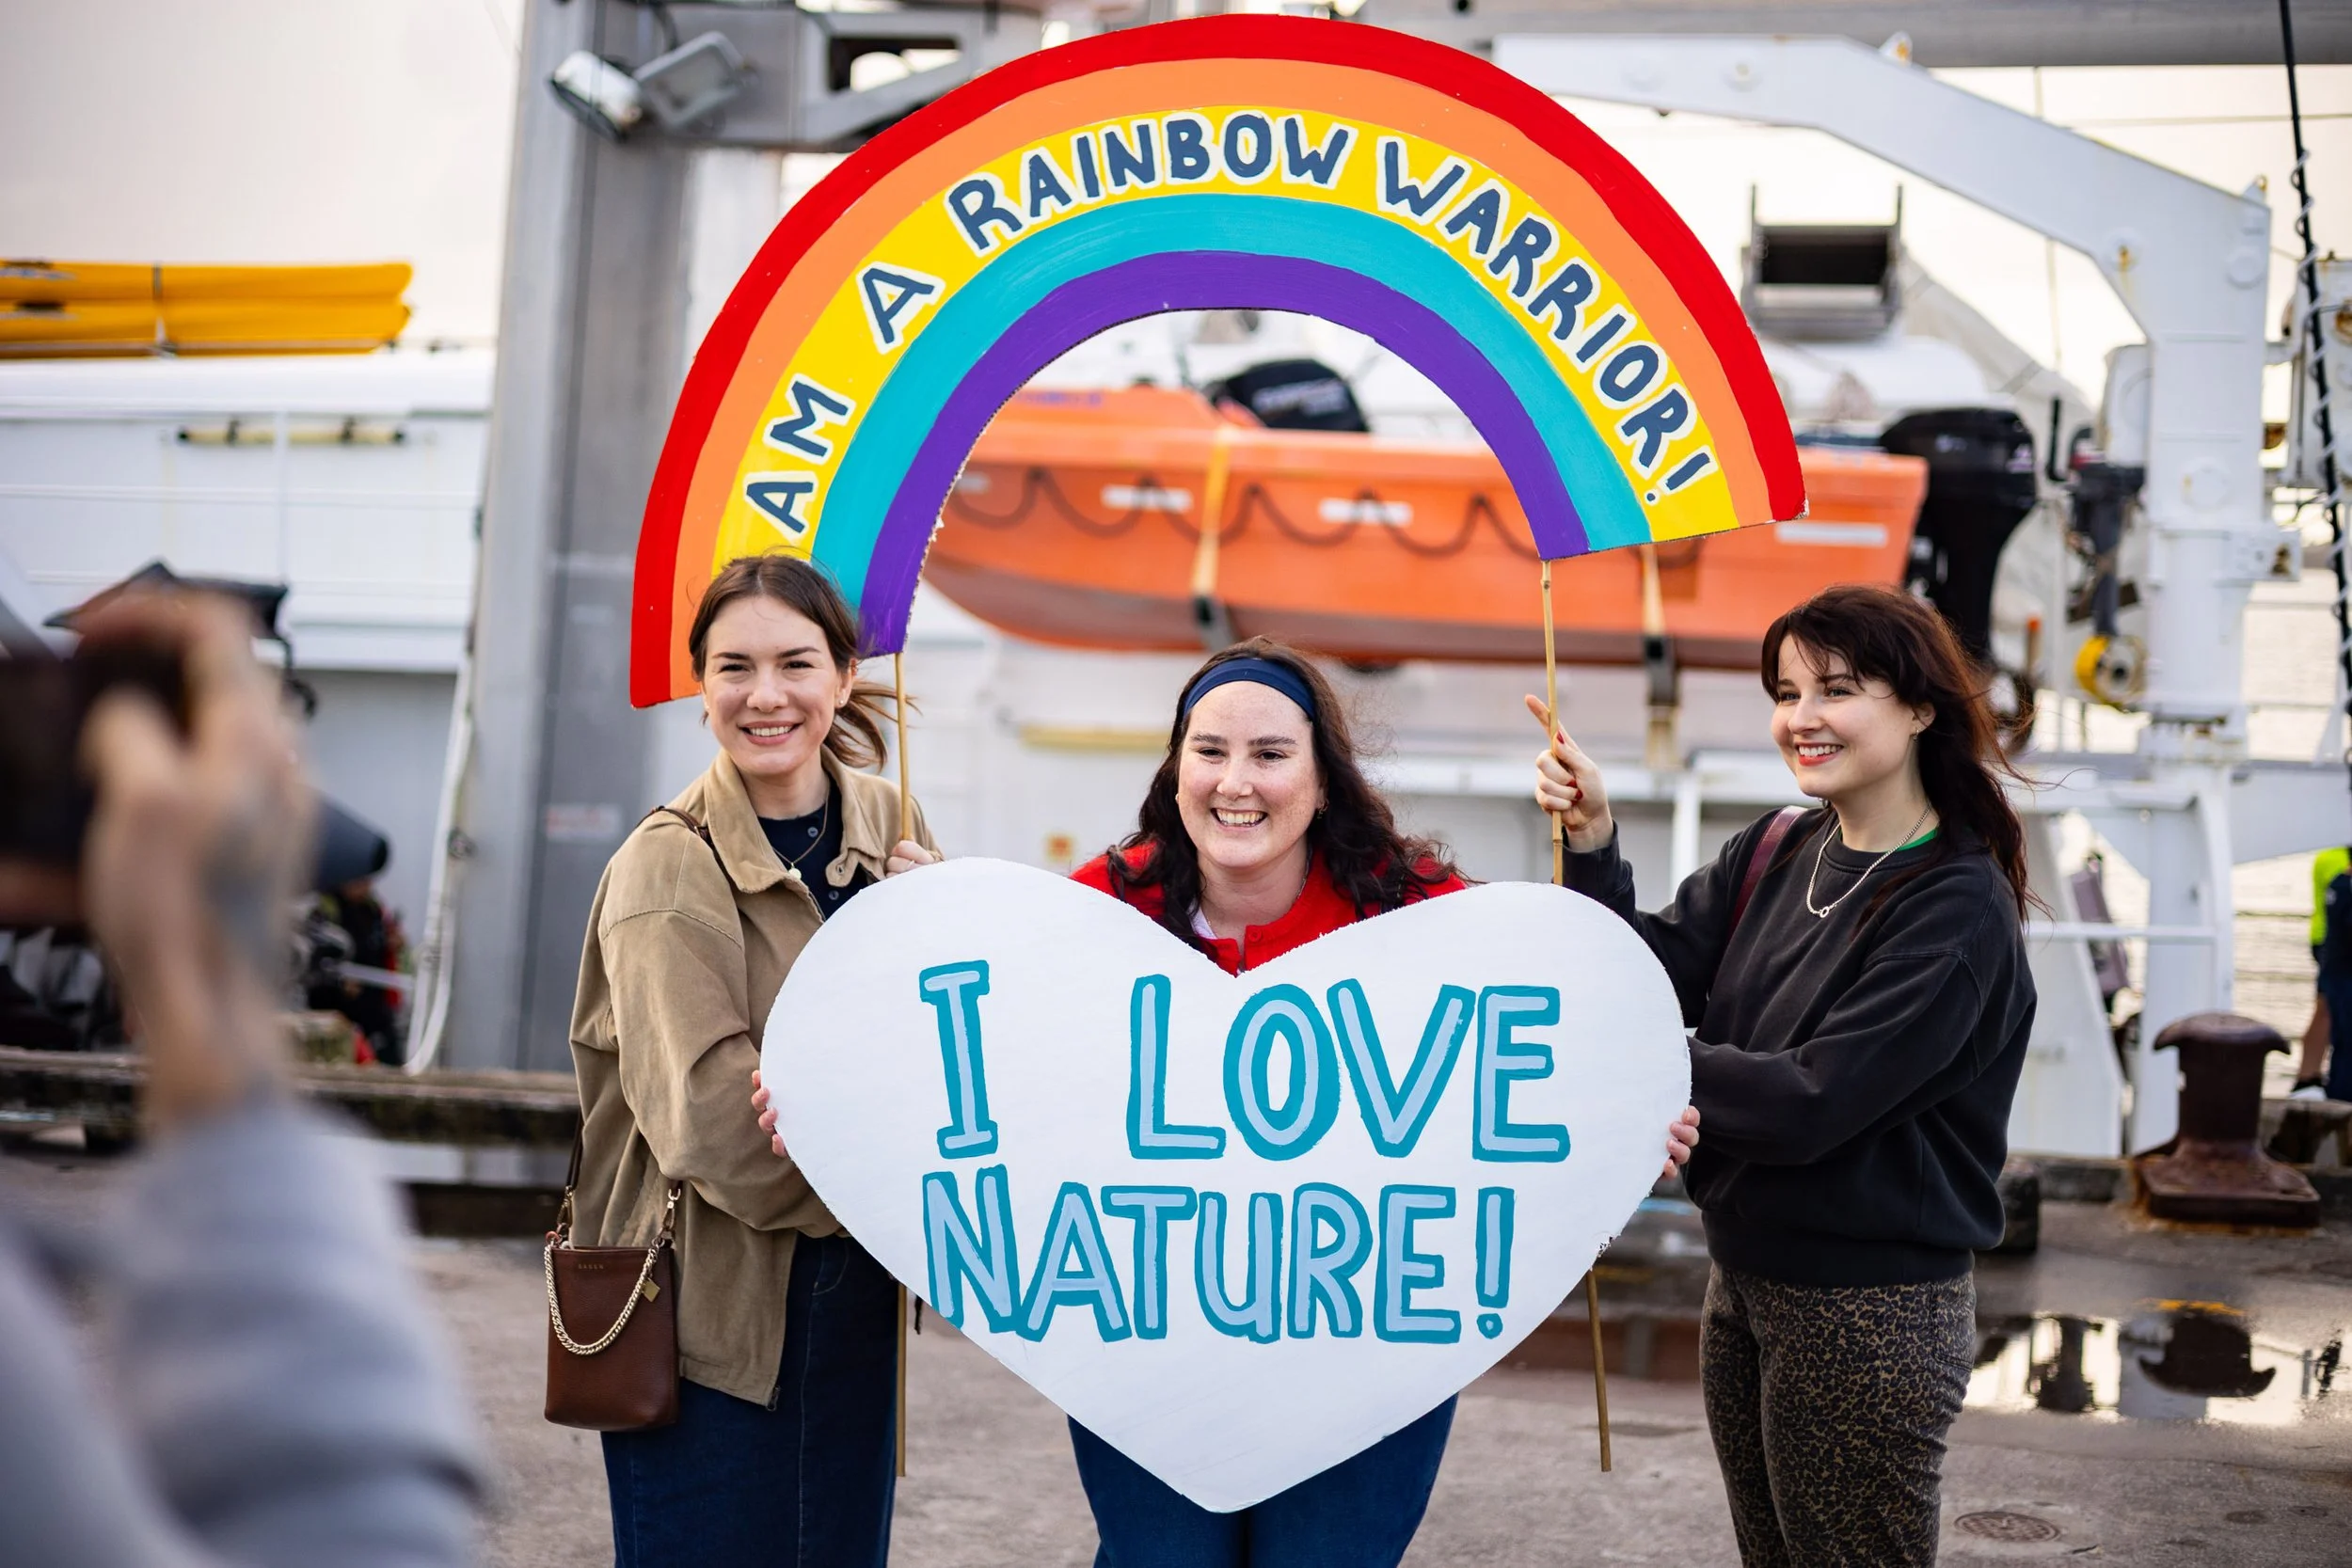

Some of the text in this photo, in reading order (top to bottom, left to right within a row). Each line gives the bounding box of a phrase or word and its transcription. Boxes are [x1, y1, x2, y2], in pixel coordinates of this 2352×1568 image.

[745, 114, 1711, 534] AM A RAINBOW WARRIOR!
[919, 959, 1571, 1163] I LOVE
[922, 1164, 1516, 1345] NATURE!
